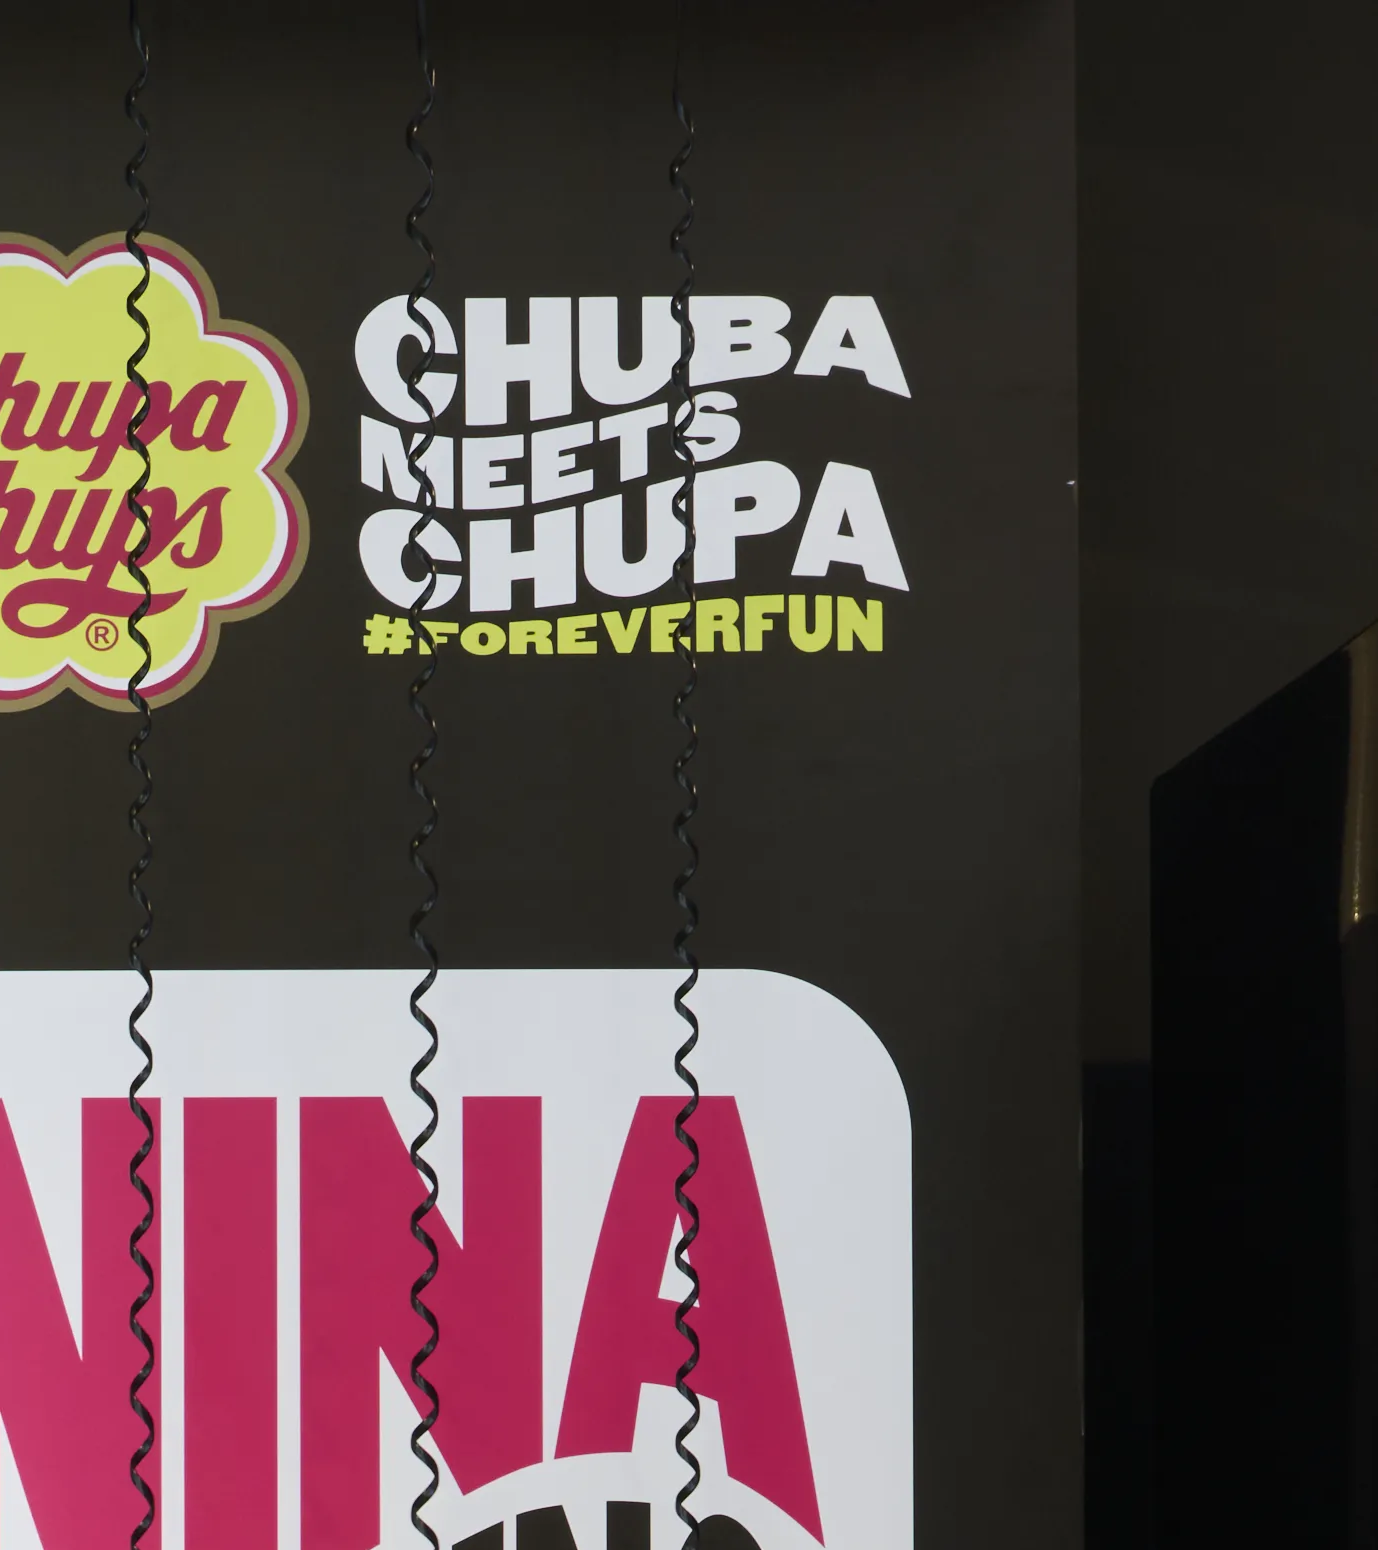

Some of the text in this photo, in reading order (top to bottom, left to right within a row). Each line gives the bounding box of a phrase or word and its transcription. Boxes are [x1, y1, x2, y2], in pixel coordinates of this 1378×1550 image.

[354, 295, 912, 424] CHUBA
[360, 390, 742, 511] MEETS
[358, 460, 910, 613] CHUPA
[363, 594, 885, 657] #FOREVERFUN
